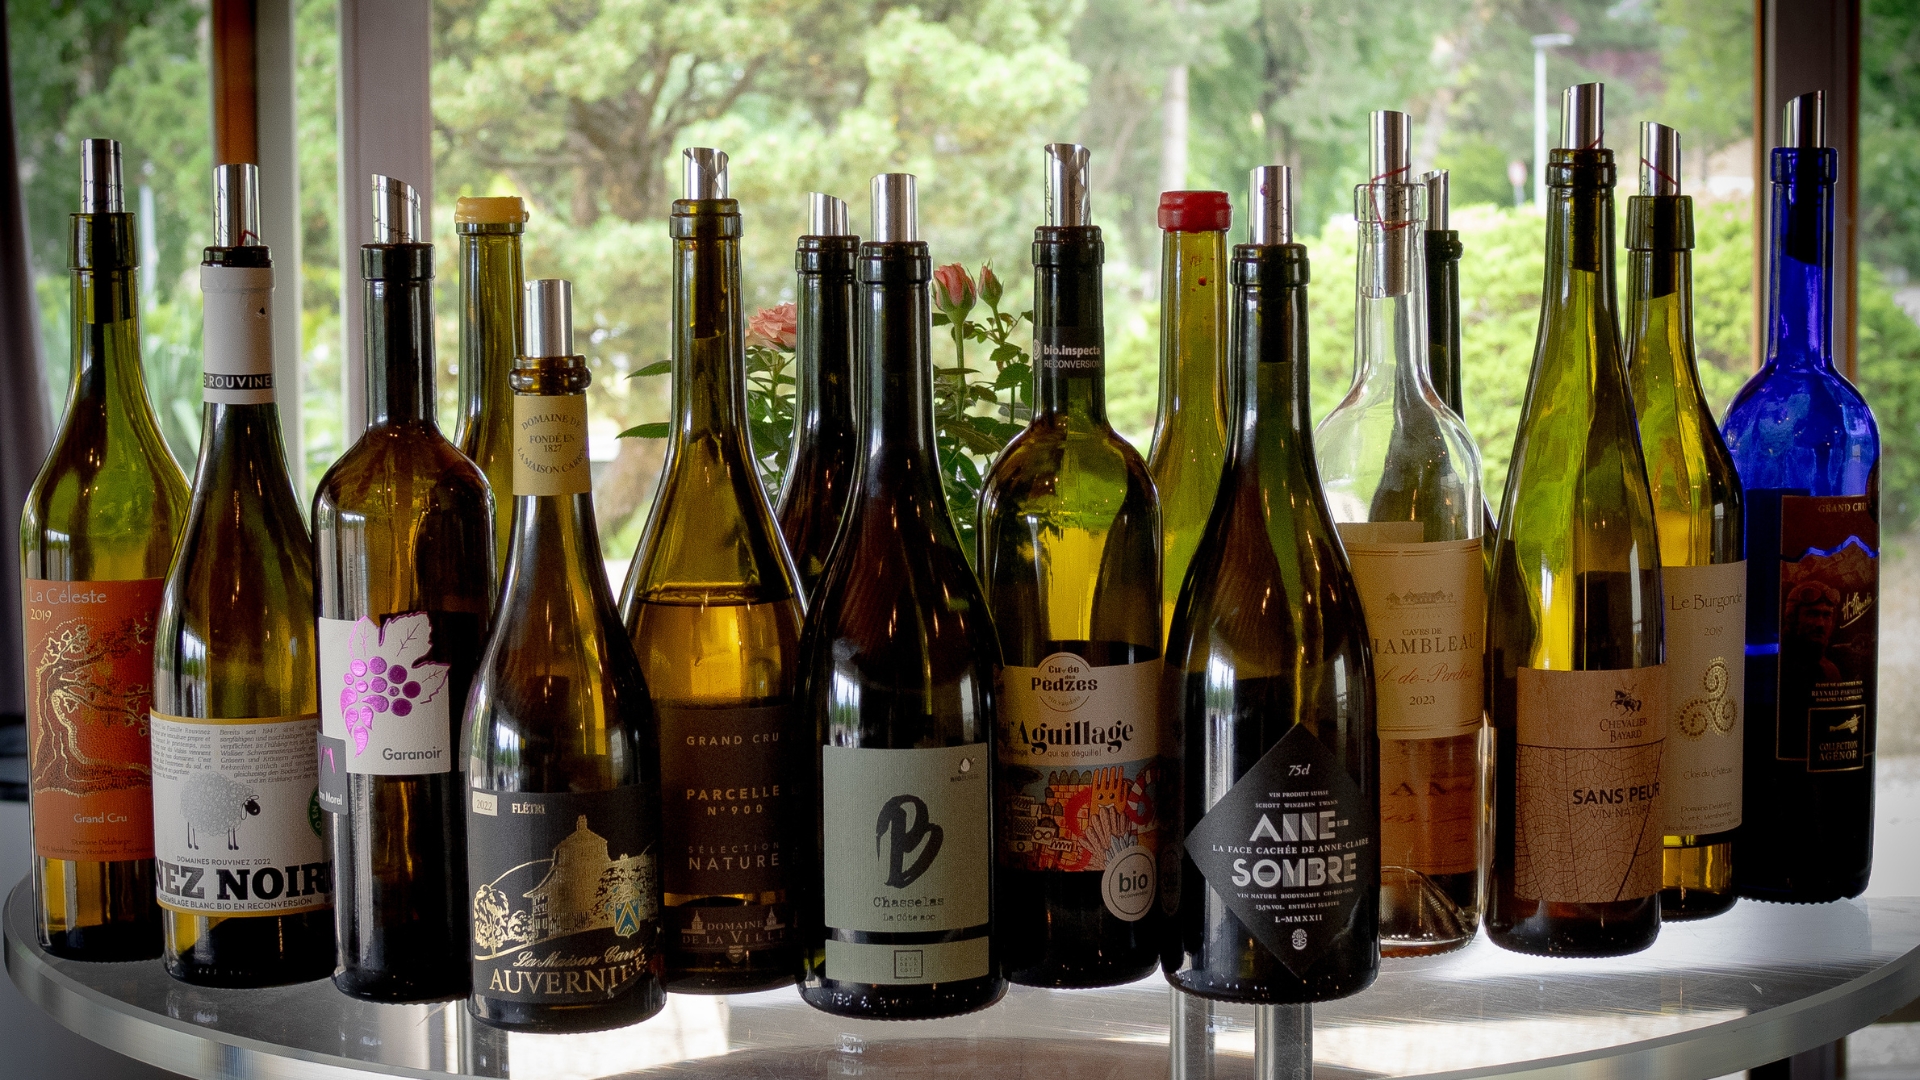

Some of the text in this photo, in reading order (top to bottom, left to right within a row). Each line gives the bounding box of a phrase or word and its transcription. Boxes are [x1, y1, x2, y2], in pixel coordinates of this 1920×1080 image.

[522, 413, 569, 431] DOMAINE
[544, 444, 563, 453] 1827
[524, 457, 560, 475] MAISON
[1818, 502, 1867, 513] GRAND CRU
[29, 585, 107, 605] La Céleste
[1671, 586, 1743, 614] Le Burgonde
[30, 608, 52, 624] 2019
[1402, 627, 1442, 636] CAVES DE
[1409, 695, 1436, 706] 2023
[686, 732, 779, 746] GRAND CRU
[1610, 730, 1642, 743] BAYARD
[1819, 740, 1858, 751] COLLECTION
[382, 746, 443, 761] Garanoir
[1819, 748, 1858, 761] AGÉNOR
[1288, 763, 1311, 777] 75cl
[325, 791, 343, 806] Morel
[686, 784, 780, 801] PARCELLE
[1282, 790, 1309, 798] PRODUIT
[1572, 782, 1660, 805] SANS PEUR
[476, 799, 493, 811] 2022
[511, 801, 546, 815] FLÉTRI
[73, 811, 128, 823] Grand Cru
[688, 842, 779, 854] SÉLECTION
[875, 793, 944, 889] B
[1212, 837, 1369, 855] LA FACE CACHÉE DE ANNE-CLAIRE
[177, 856, 272, 866] DOMAINES ROUVINEZ 2022
[688, 852, 779, 871] NATURE
[1231, 852, 1357, 888] SOMBRE
[155, 858, 330, 900] NEZ NOIR
[1119, 870, 1149, 893] bio
[873, 896, 944, 908] Chasselas
[1280, 891, 1320, 899] BIODYNAMIE
[190, 899, 215, 910] BLANC
[216, 901, 232, 910] BIO
[233, 901, 245, 910] EN
[247, 897, 313, 910] RECONVERSION
[707, 920, 764, 931] DOMAINE
[682, 934, 700, 944] DE
[706, 935, 724, 944] LA
[513, 950, 540, 968] La
[537, 949, 602, 968] Maison
[489, 956, 647, 995] AUVERNIER
